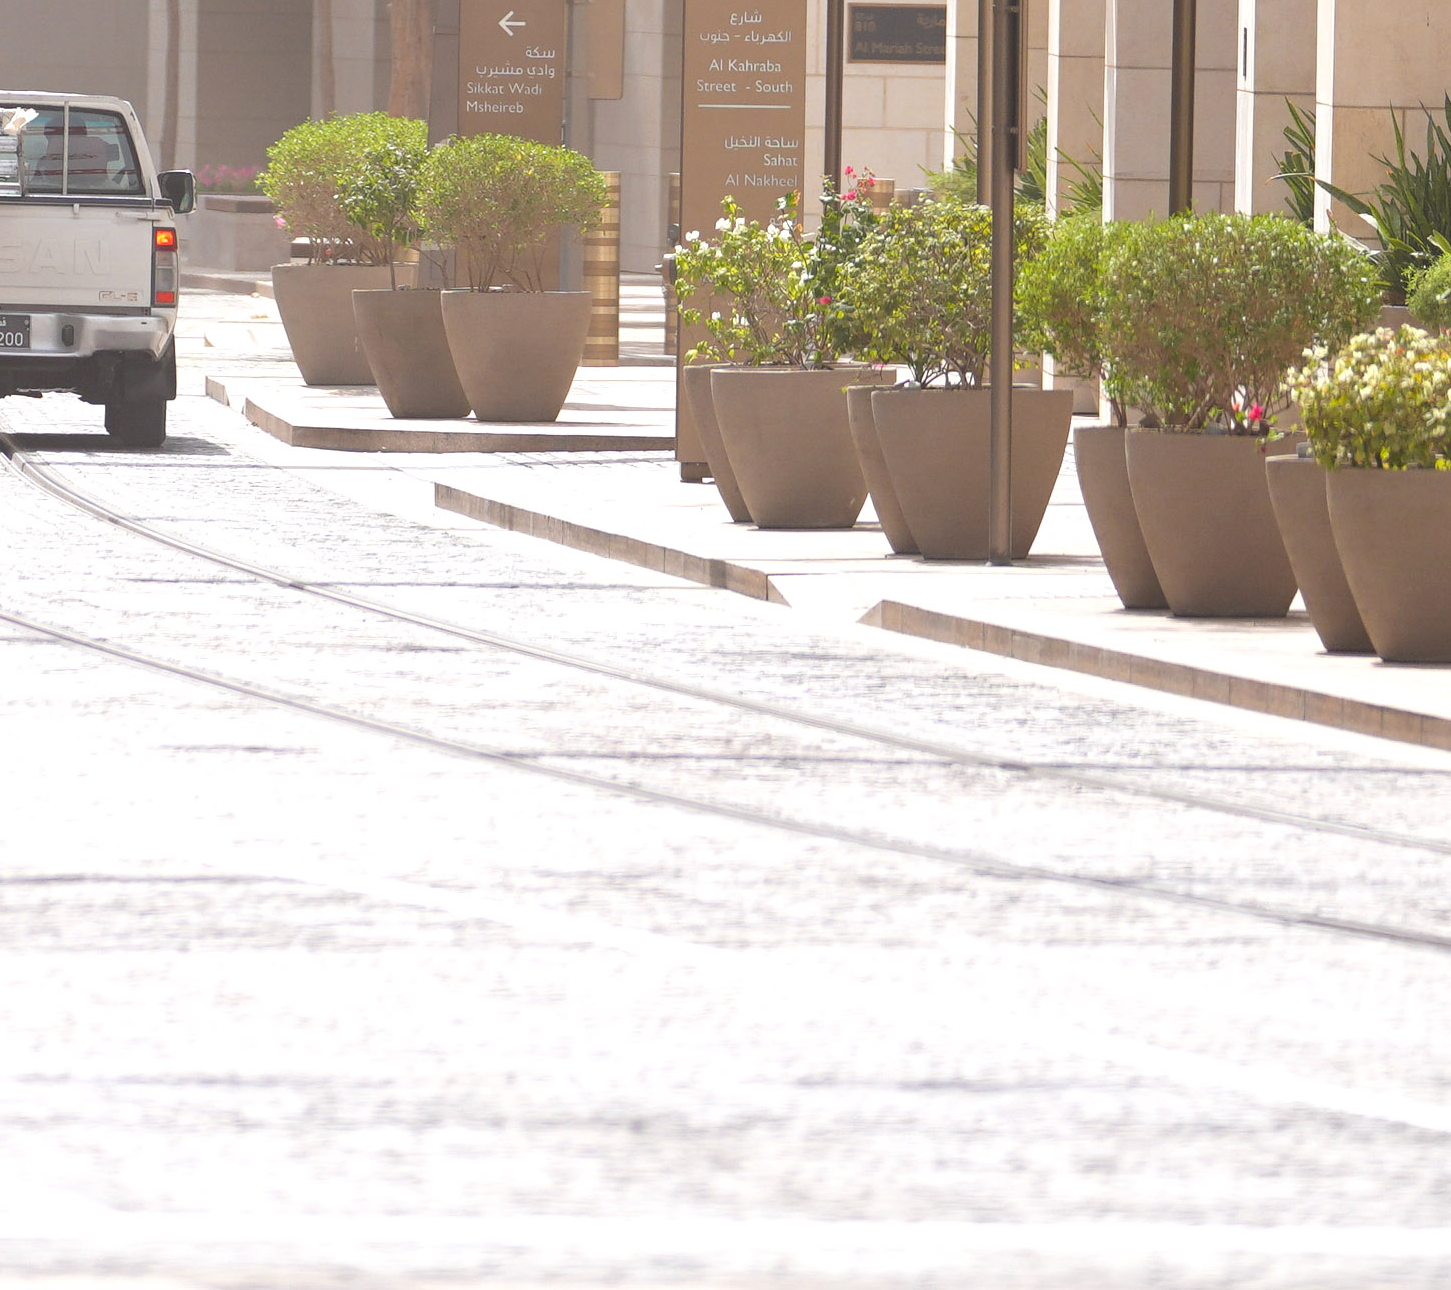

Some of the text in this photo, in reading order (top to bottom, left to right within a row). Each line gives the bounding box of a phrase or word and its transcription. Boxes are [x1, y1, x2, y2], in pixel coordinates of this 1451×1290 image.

[729, 9, 762, 26] شارع
[699, 30, 730, 44] جنوب
[744, 30, 792, 45] الكهرباء
[525, 46, 556, 59] سكة
[475, 60, 556, 79] وادي مشيرب
[709, 59, 781, 73] Al Kahraba
[466, 81, 543, 95] Sikkat Wadi
[697, 79, 737, 93] Street
[755, 80, 794, 94] South
[466, 100, 524, 114] Msheireb
[724, 135, 799, 151] ساحة النخيل
[763, 153, 799, 167] Sahat
[724, 173, 798, 188] Al Nakheel
